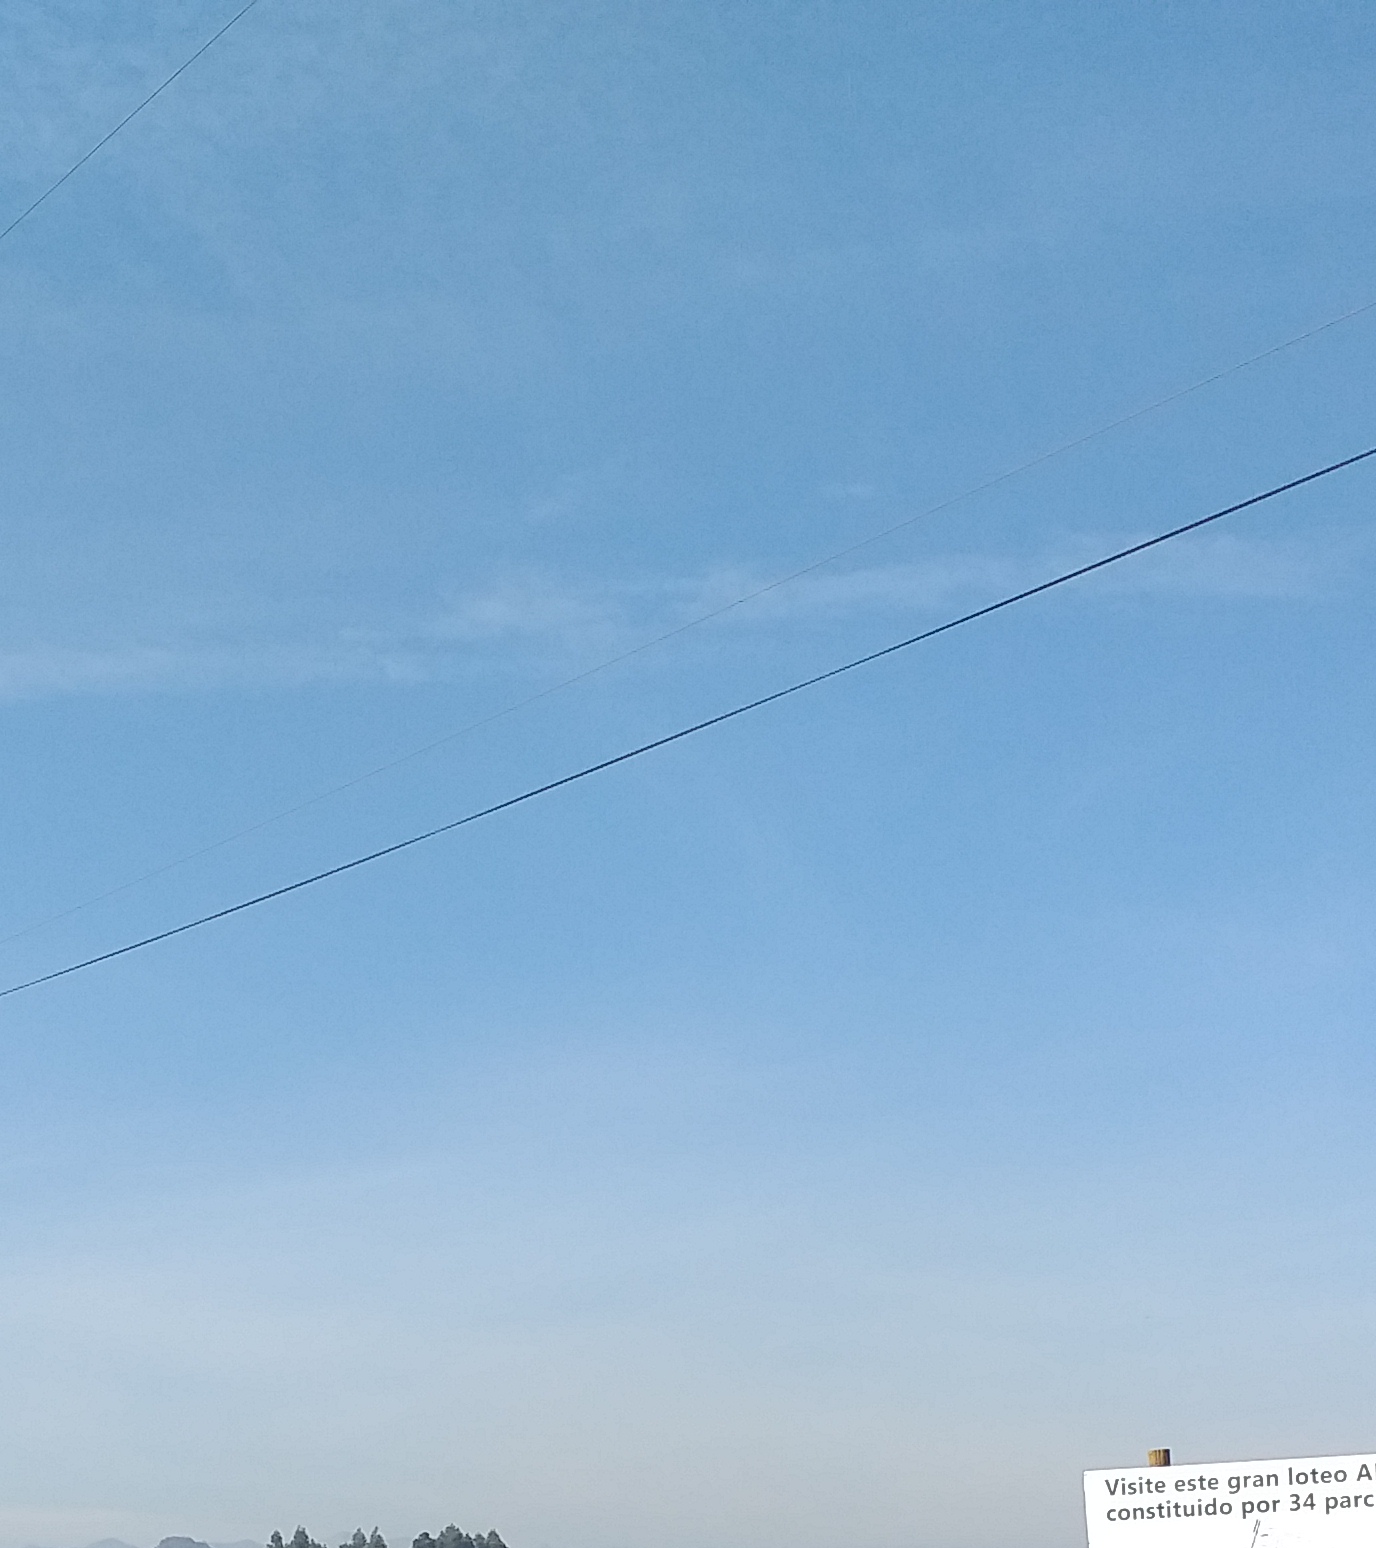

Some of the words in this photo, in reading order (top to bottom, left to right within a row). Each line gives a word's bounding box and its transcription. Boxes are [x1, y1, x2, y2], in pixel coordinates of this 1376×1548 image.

[1105, 1476, 1166, 1496] Visite
[1174, 1474, 1219, 1492] este
[1227, 1471, 1279, 1494] gran
[1288, 1467, 1348, 1486] loteo
[1106, 1498, 1233, 1522] constituido
[1242, 1498, 1280, 1519] por
[1289, 1493, 1316, 1512] 34
